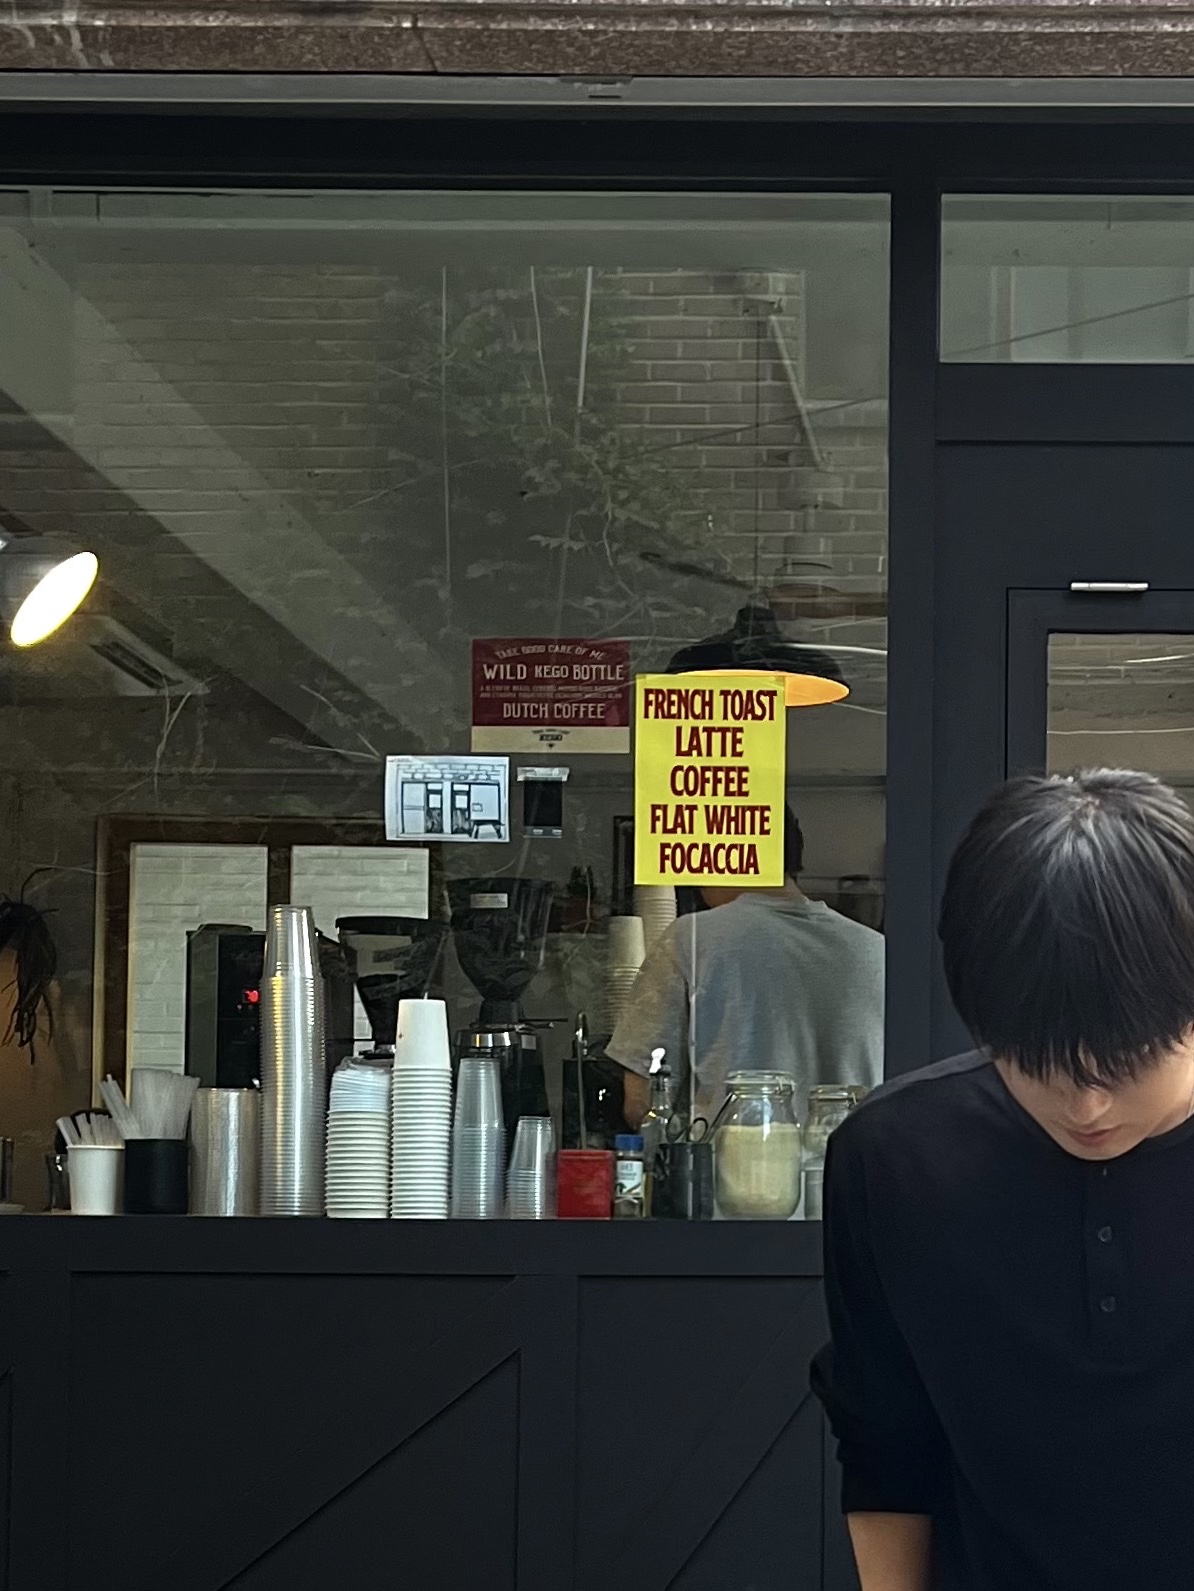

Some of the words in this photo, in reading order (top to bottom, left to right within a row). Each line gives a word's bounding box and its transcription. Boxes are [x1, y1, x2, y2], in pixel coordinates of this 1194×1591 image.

[548, 645, 573, 654] CARE
[483, 664, 527, 680] WILD
[534, 665, 569, 678] KEGO
[572, 664, 625, 680] BOTTLE
[503, 703, 549, 719] DUTCH
[553, 703, 606, 719] COFFEE
[644, 688, 714, 719] FRENCH
[720, 689, 777, 720] TOAST
[676, 726, 743, 757] LATTE
[670, 764, 749, 797] COFFEE
[650, 804, 697, 834] FLAT
[704, 804, 771, 836] WHITE
[660, 842, 760, 874] FOCACCIA
